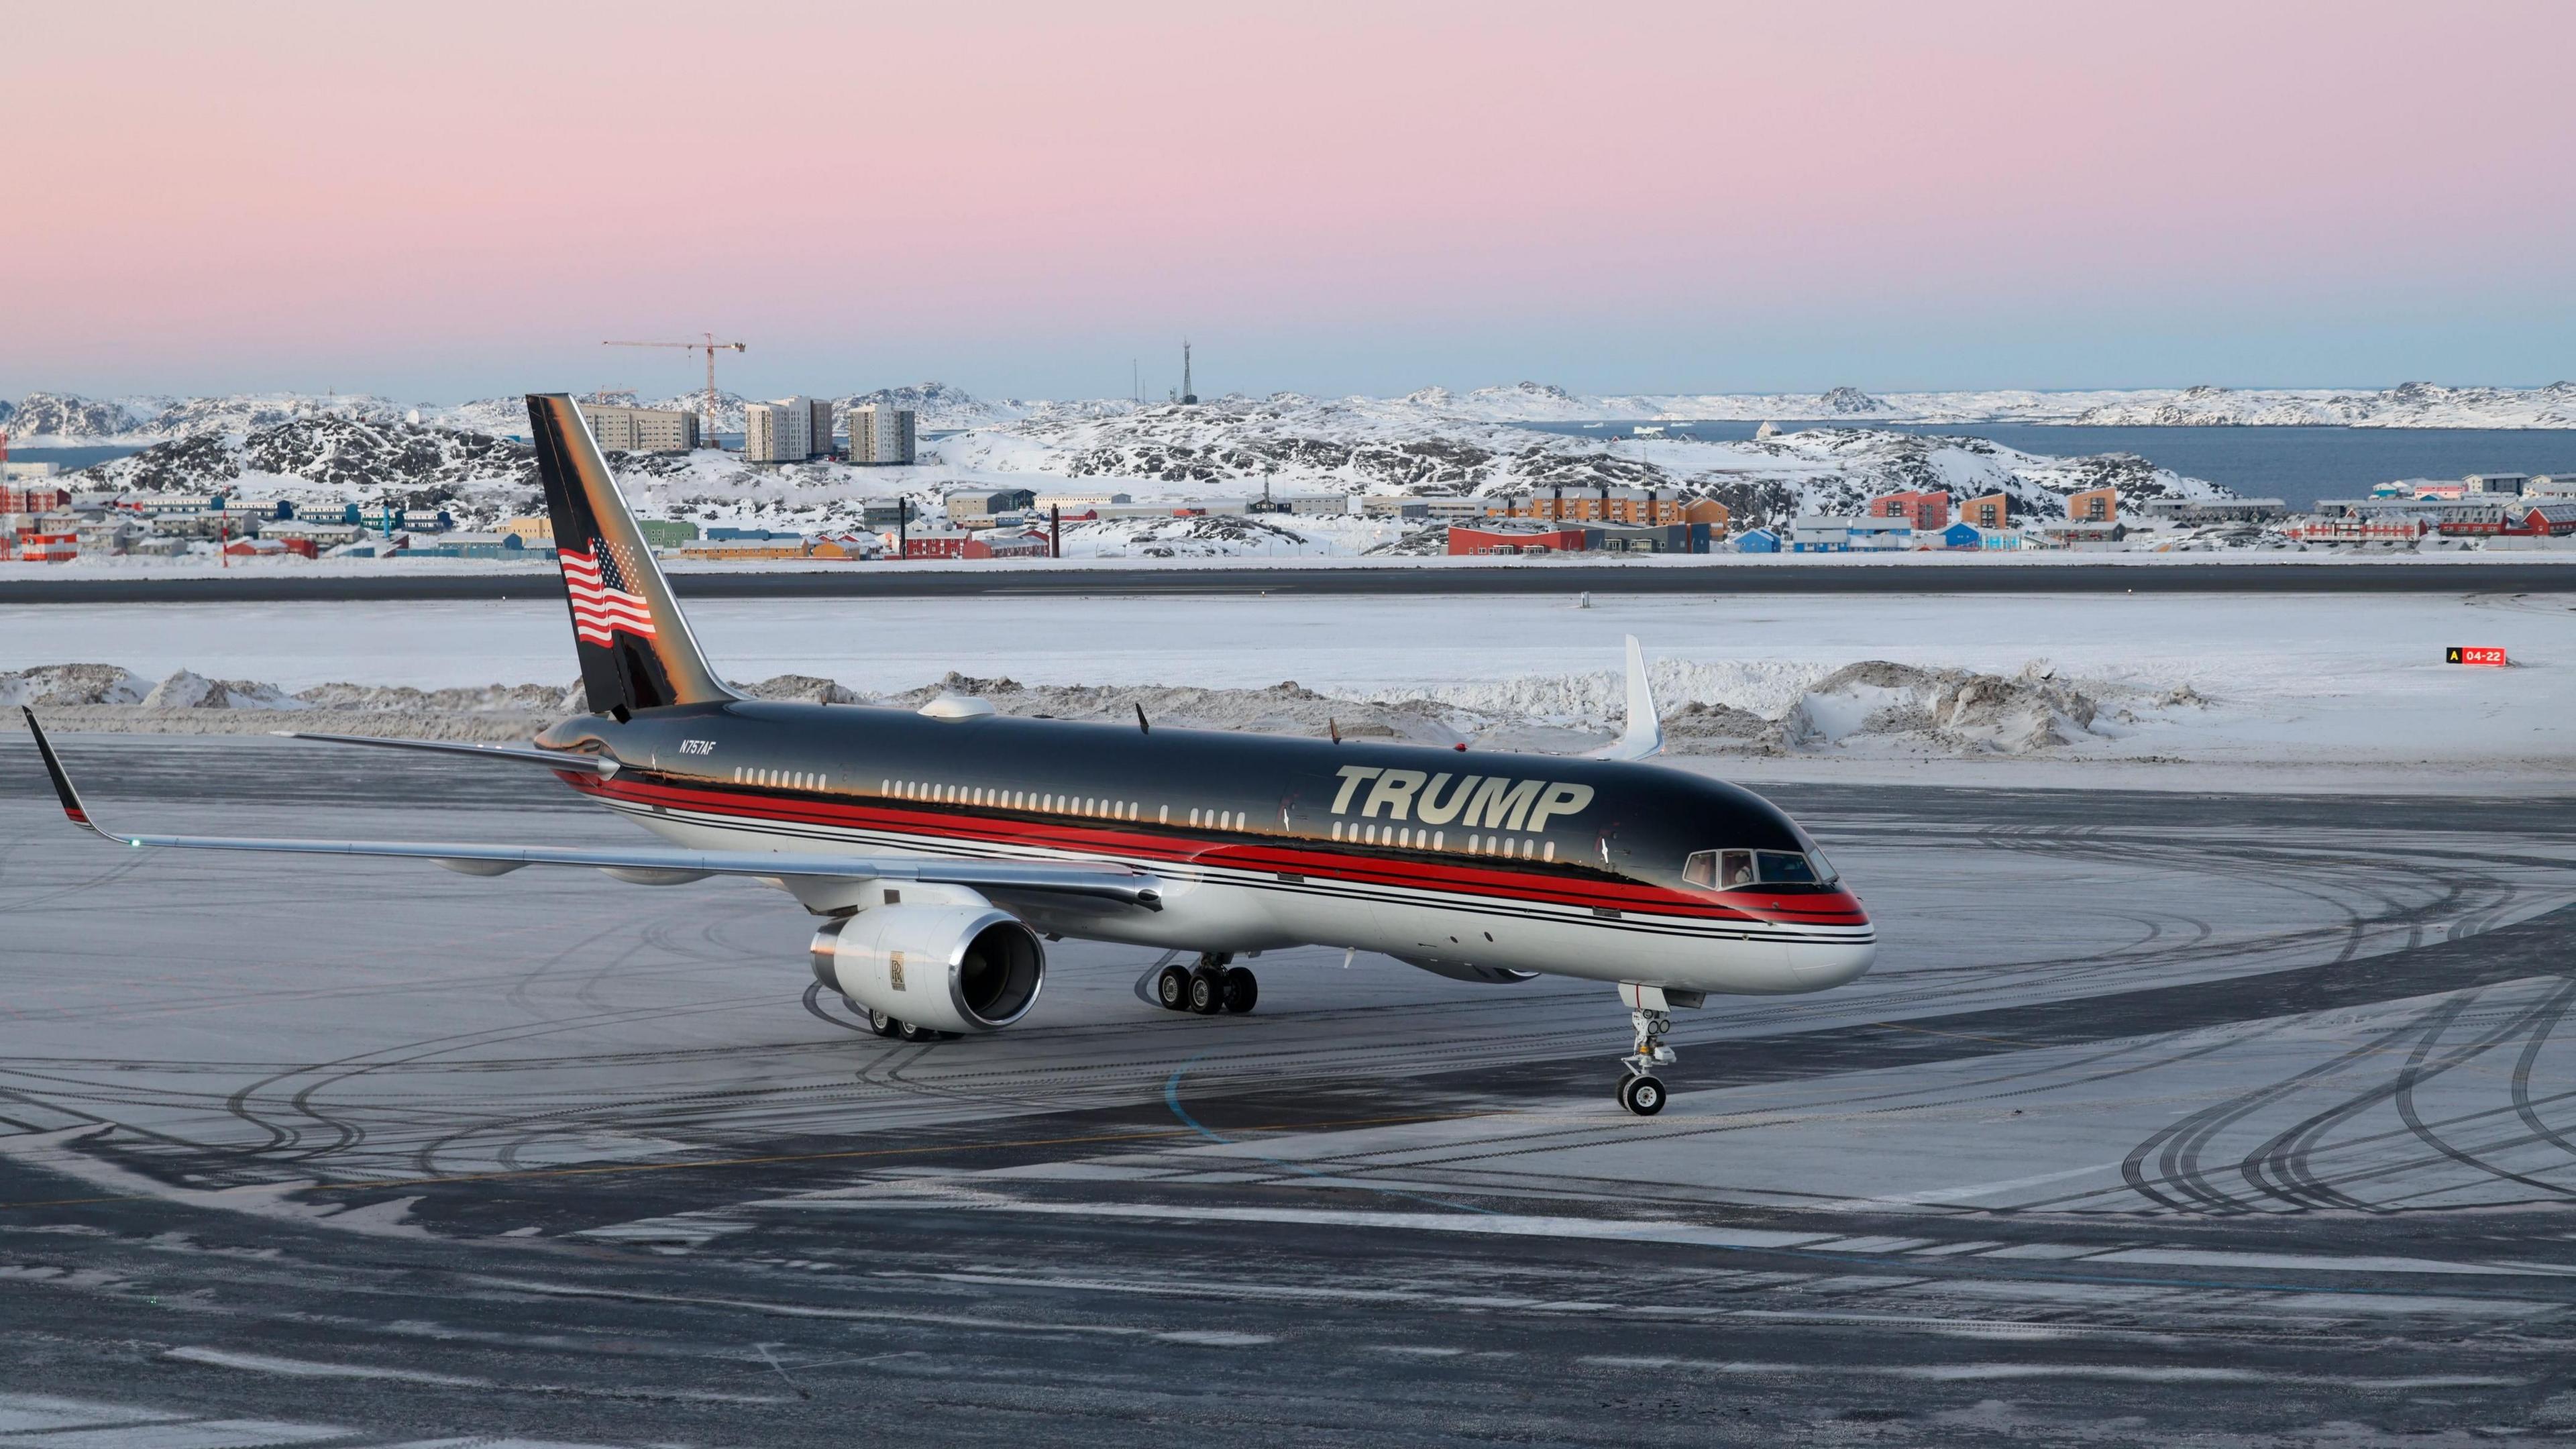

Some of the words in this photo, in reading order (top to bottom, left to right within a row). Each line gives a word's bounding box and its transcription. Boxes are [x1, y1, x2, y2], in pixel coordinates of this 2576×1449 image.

[2450, 650, 2459, 661] A
[2466, 651, 2501, 661] 04-22
[679, 739, 716, 755] N757AF
[1330, 765, 1595, 833] TRUMP
